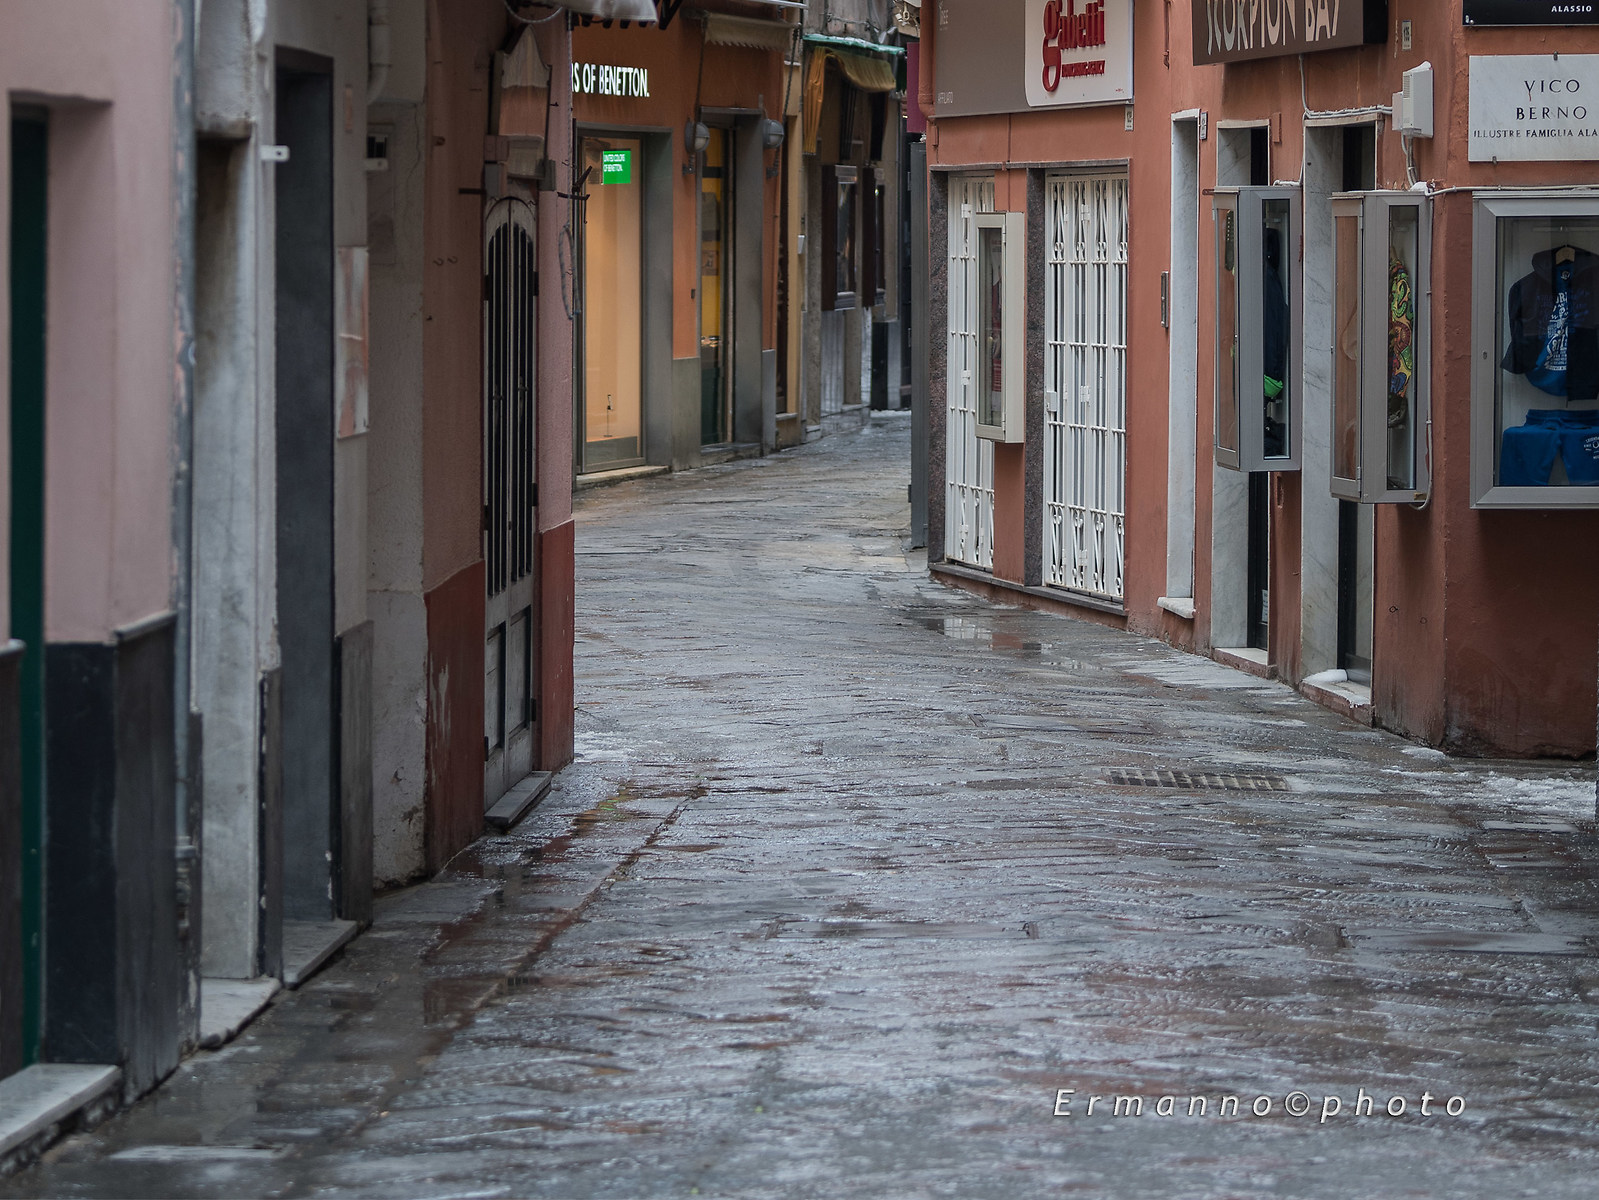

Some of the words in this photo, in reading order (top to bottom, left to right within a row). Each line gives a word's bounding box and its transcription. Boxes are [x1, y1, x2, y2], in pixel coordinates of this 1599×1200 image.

[1551, 5, 1593, 13] ALASSIO
[582, 63, 597, 94] OF
[599, 65, 650, 97] BENETTON.
[1524, 79, 1581, 94] VICO
[1516, 105, 1588, 121] BERNO
[1473, 129, 1522, 138] ILLUSTRE
[1525, 128, 1574, 138] FAMIGLIA
